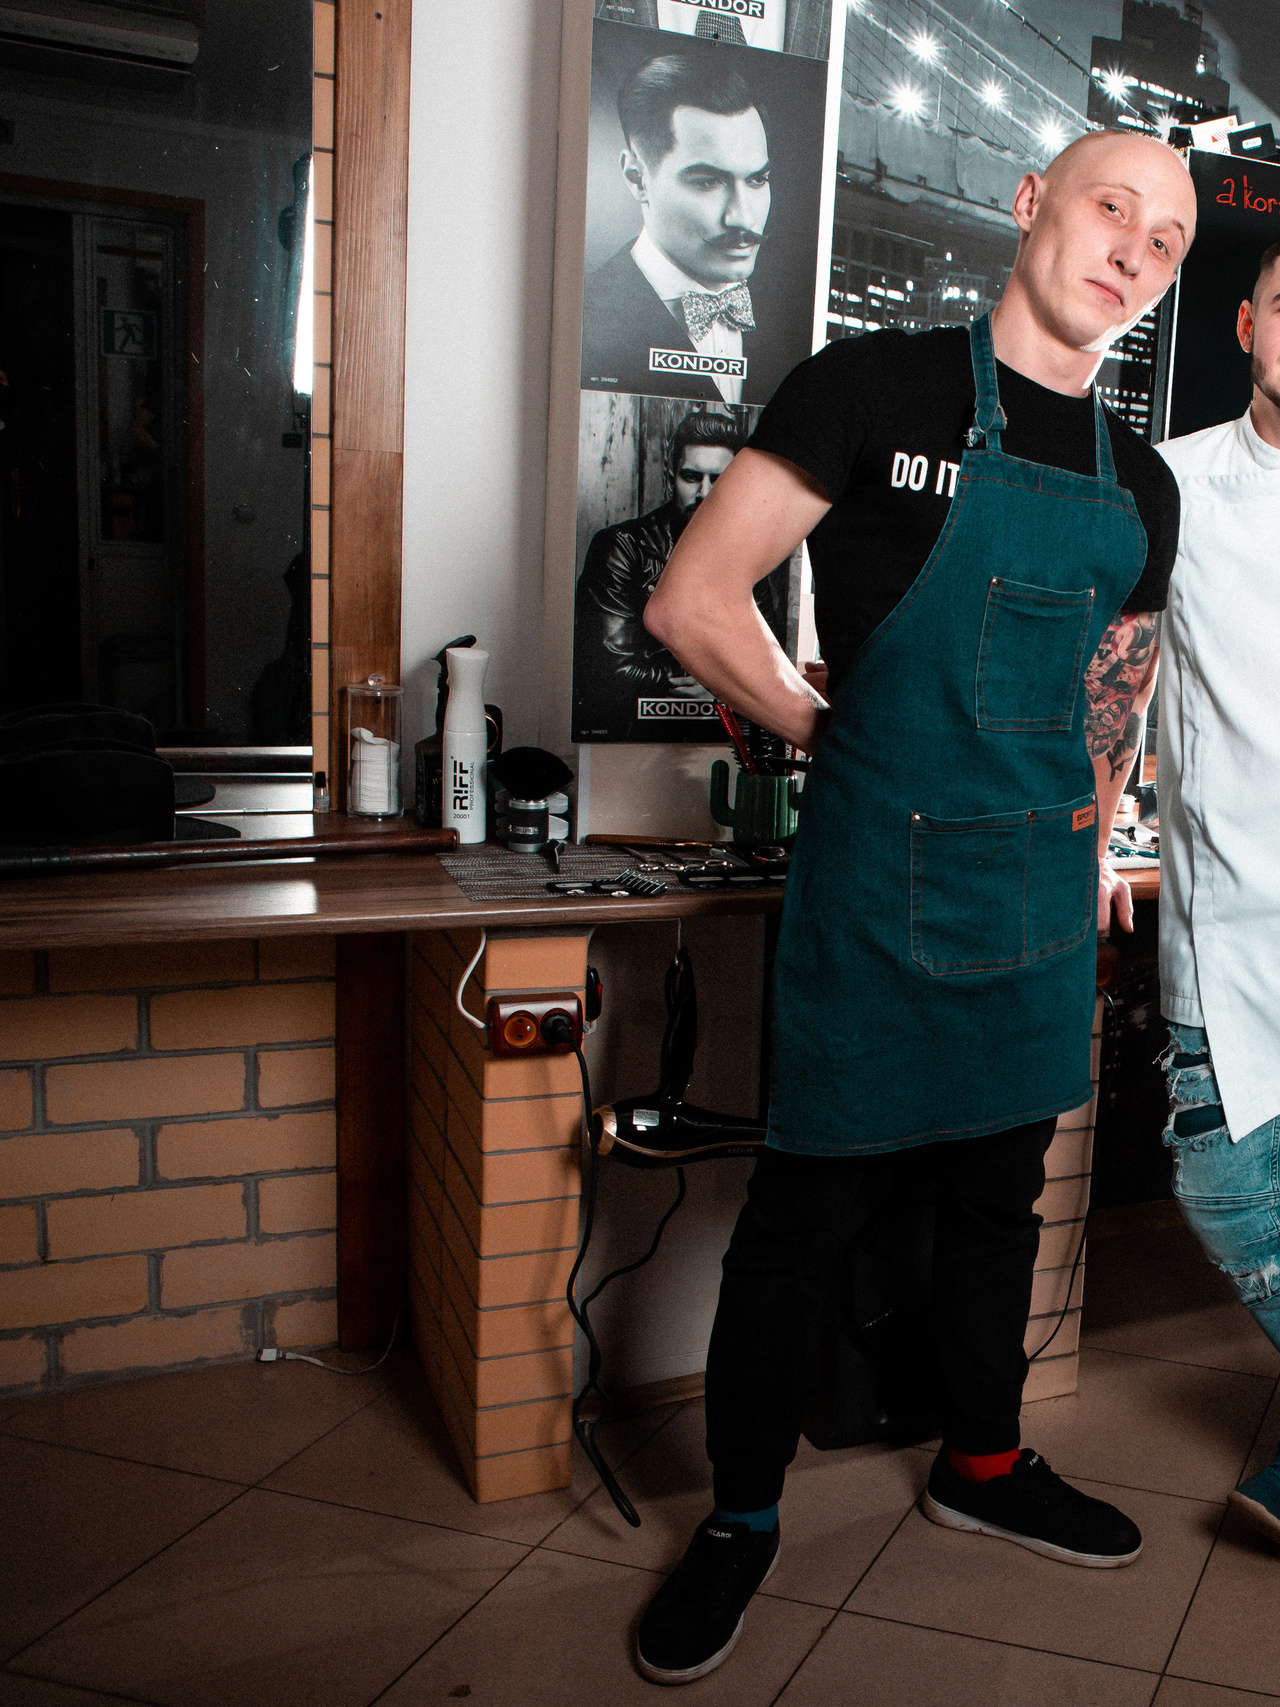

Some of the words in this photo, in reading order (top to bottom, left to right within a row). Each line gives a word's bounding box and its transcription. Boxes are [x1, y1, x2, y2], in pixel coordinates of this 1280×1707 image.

[653, 352, 742, 375] KONDOR
[891, 451, 929, 492] DO
[935, 459, 961, 498] IT
[642, 701, 718, 716] KONDO
